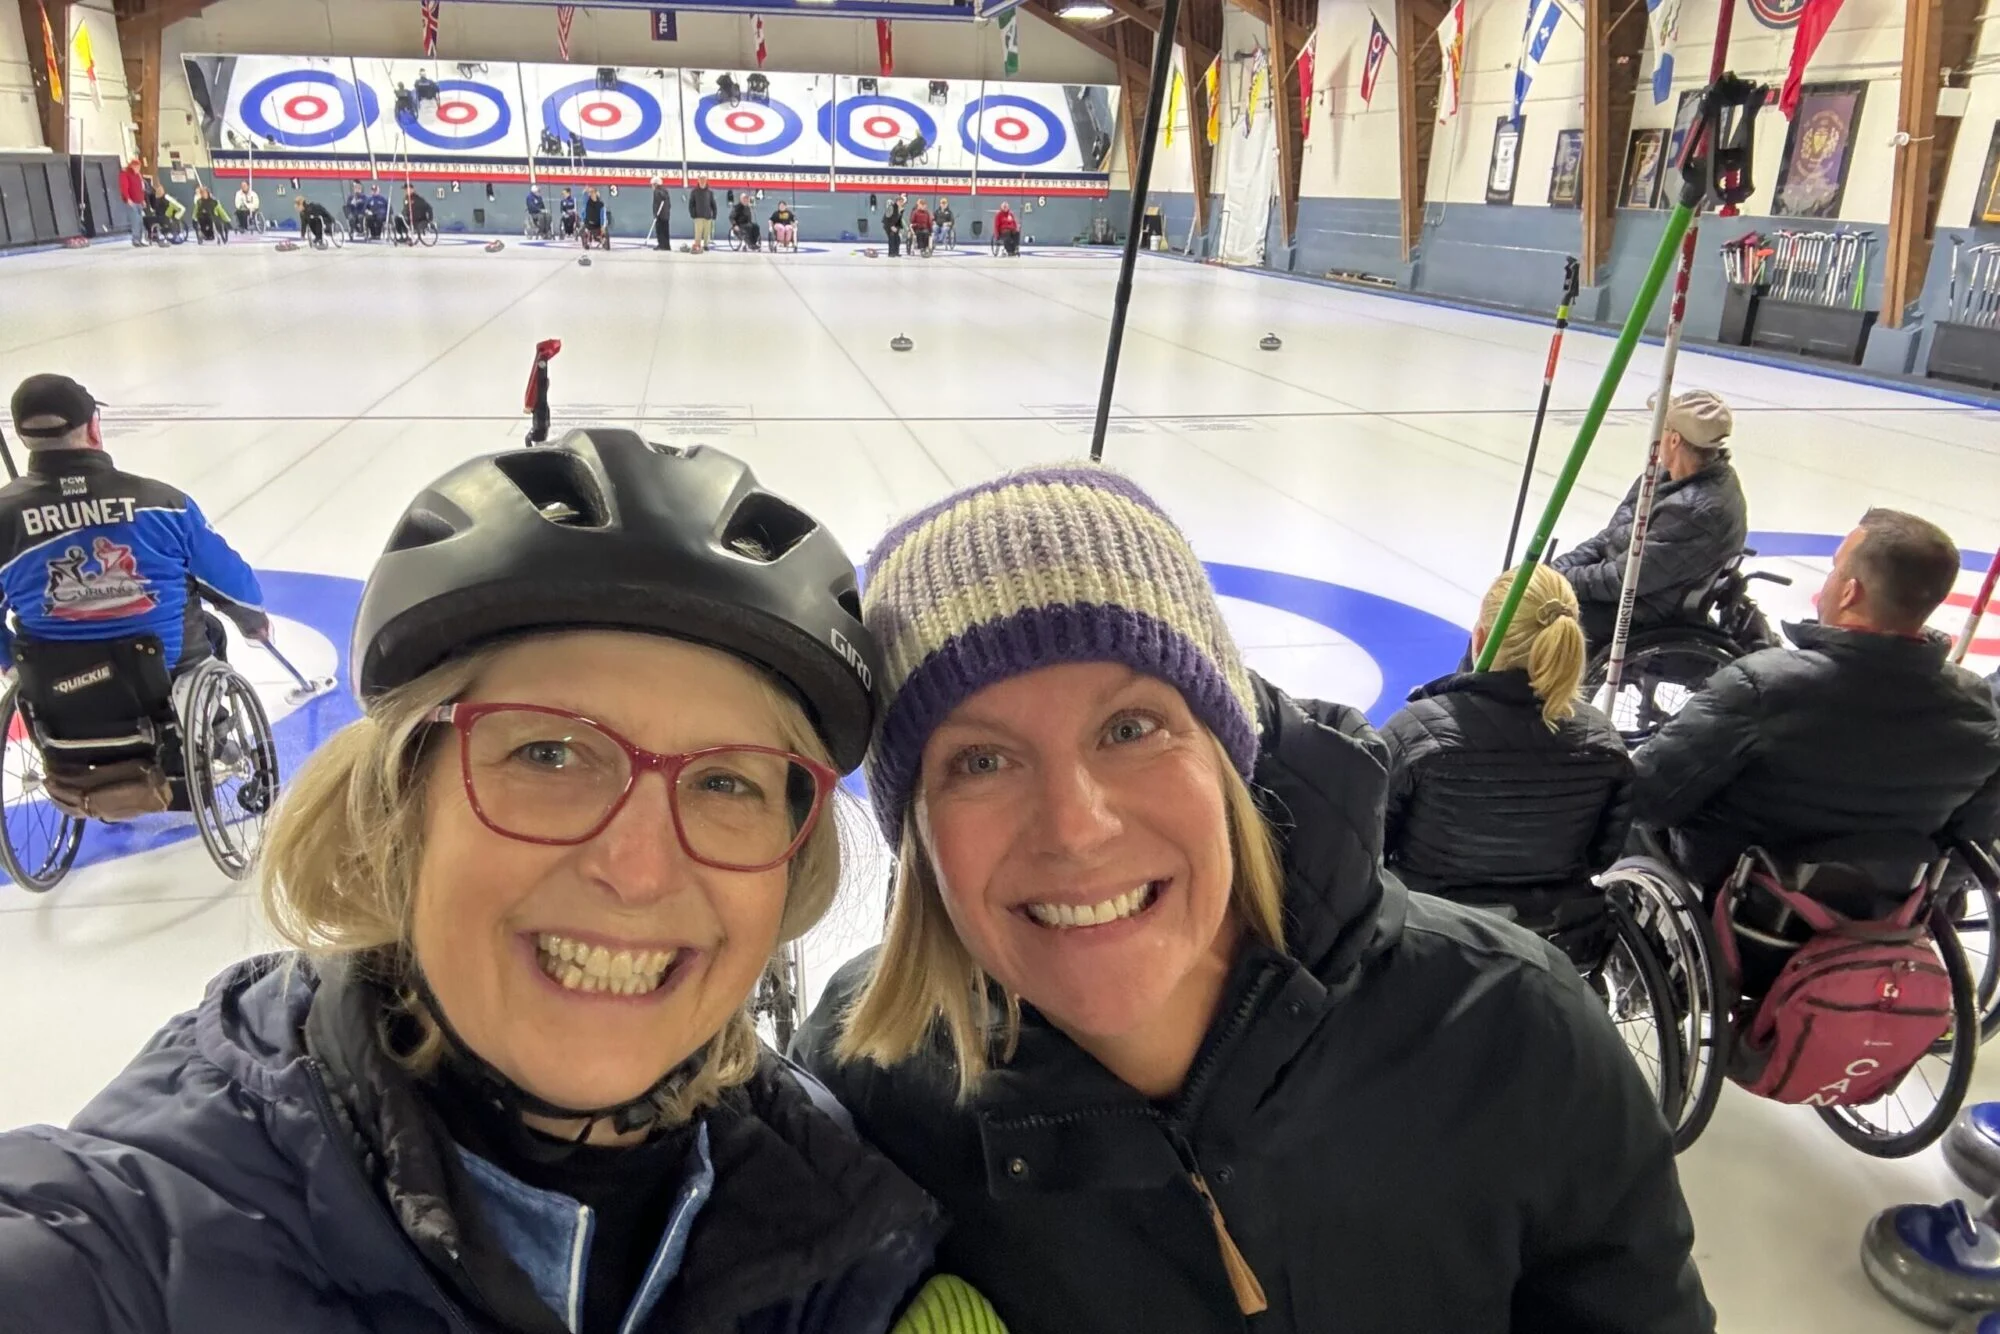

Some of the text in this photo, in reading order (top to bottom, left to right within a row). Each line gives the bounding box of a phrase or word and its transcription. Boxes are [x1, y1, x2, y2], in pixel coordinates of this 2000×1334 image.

[293, 178, 299, 190] 1
[452, 181, 460, 192] 2
[610, 184, 618, 196] 3
[756, 190, 763, 200] 4
[1038, 196, 1046, 206] 6
[1632, 440, 1661, 557] CAADA
[22, 497, 136, 536] BRUNET
[1615, 588, 1635, 645] THURSTON
[830, 628, 872, 692] GIRO
[58, 665, 111, 694] QUICKIE
